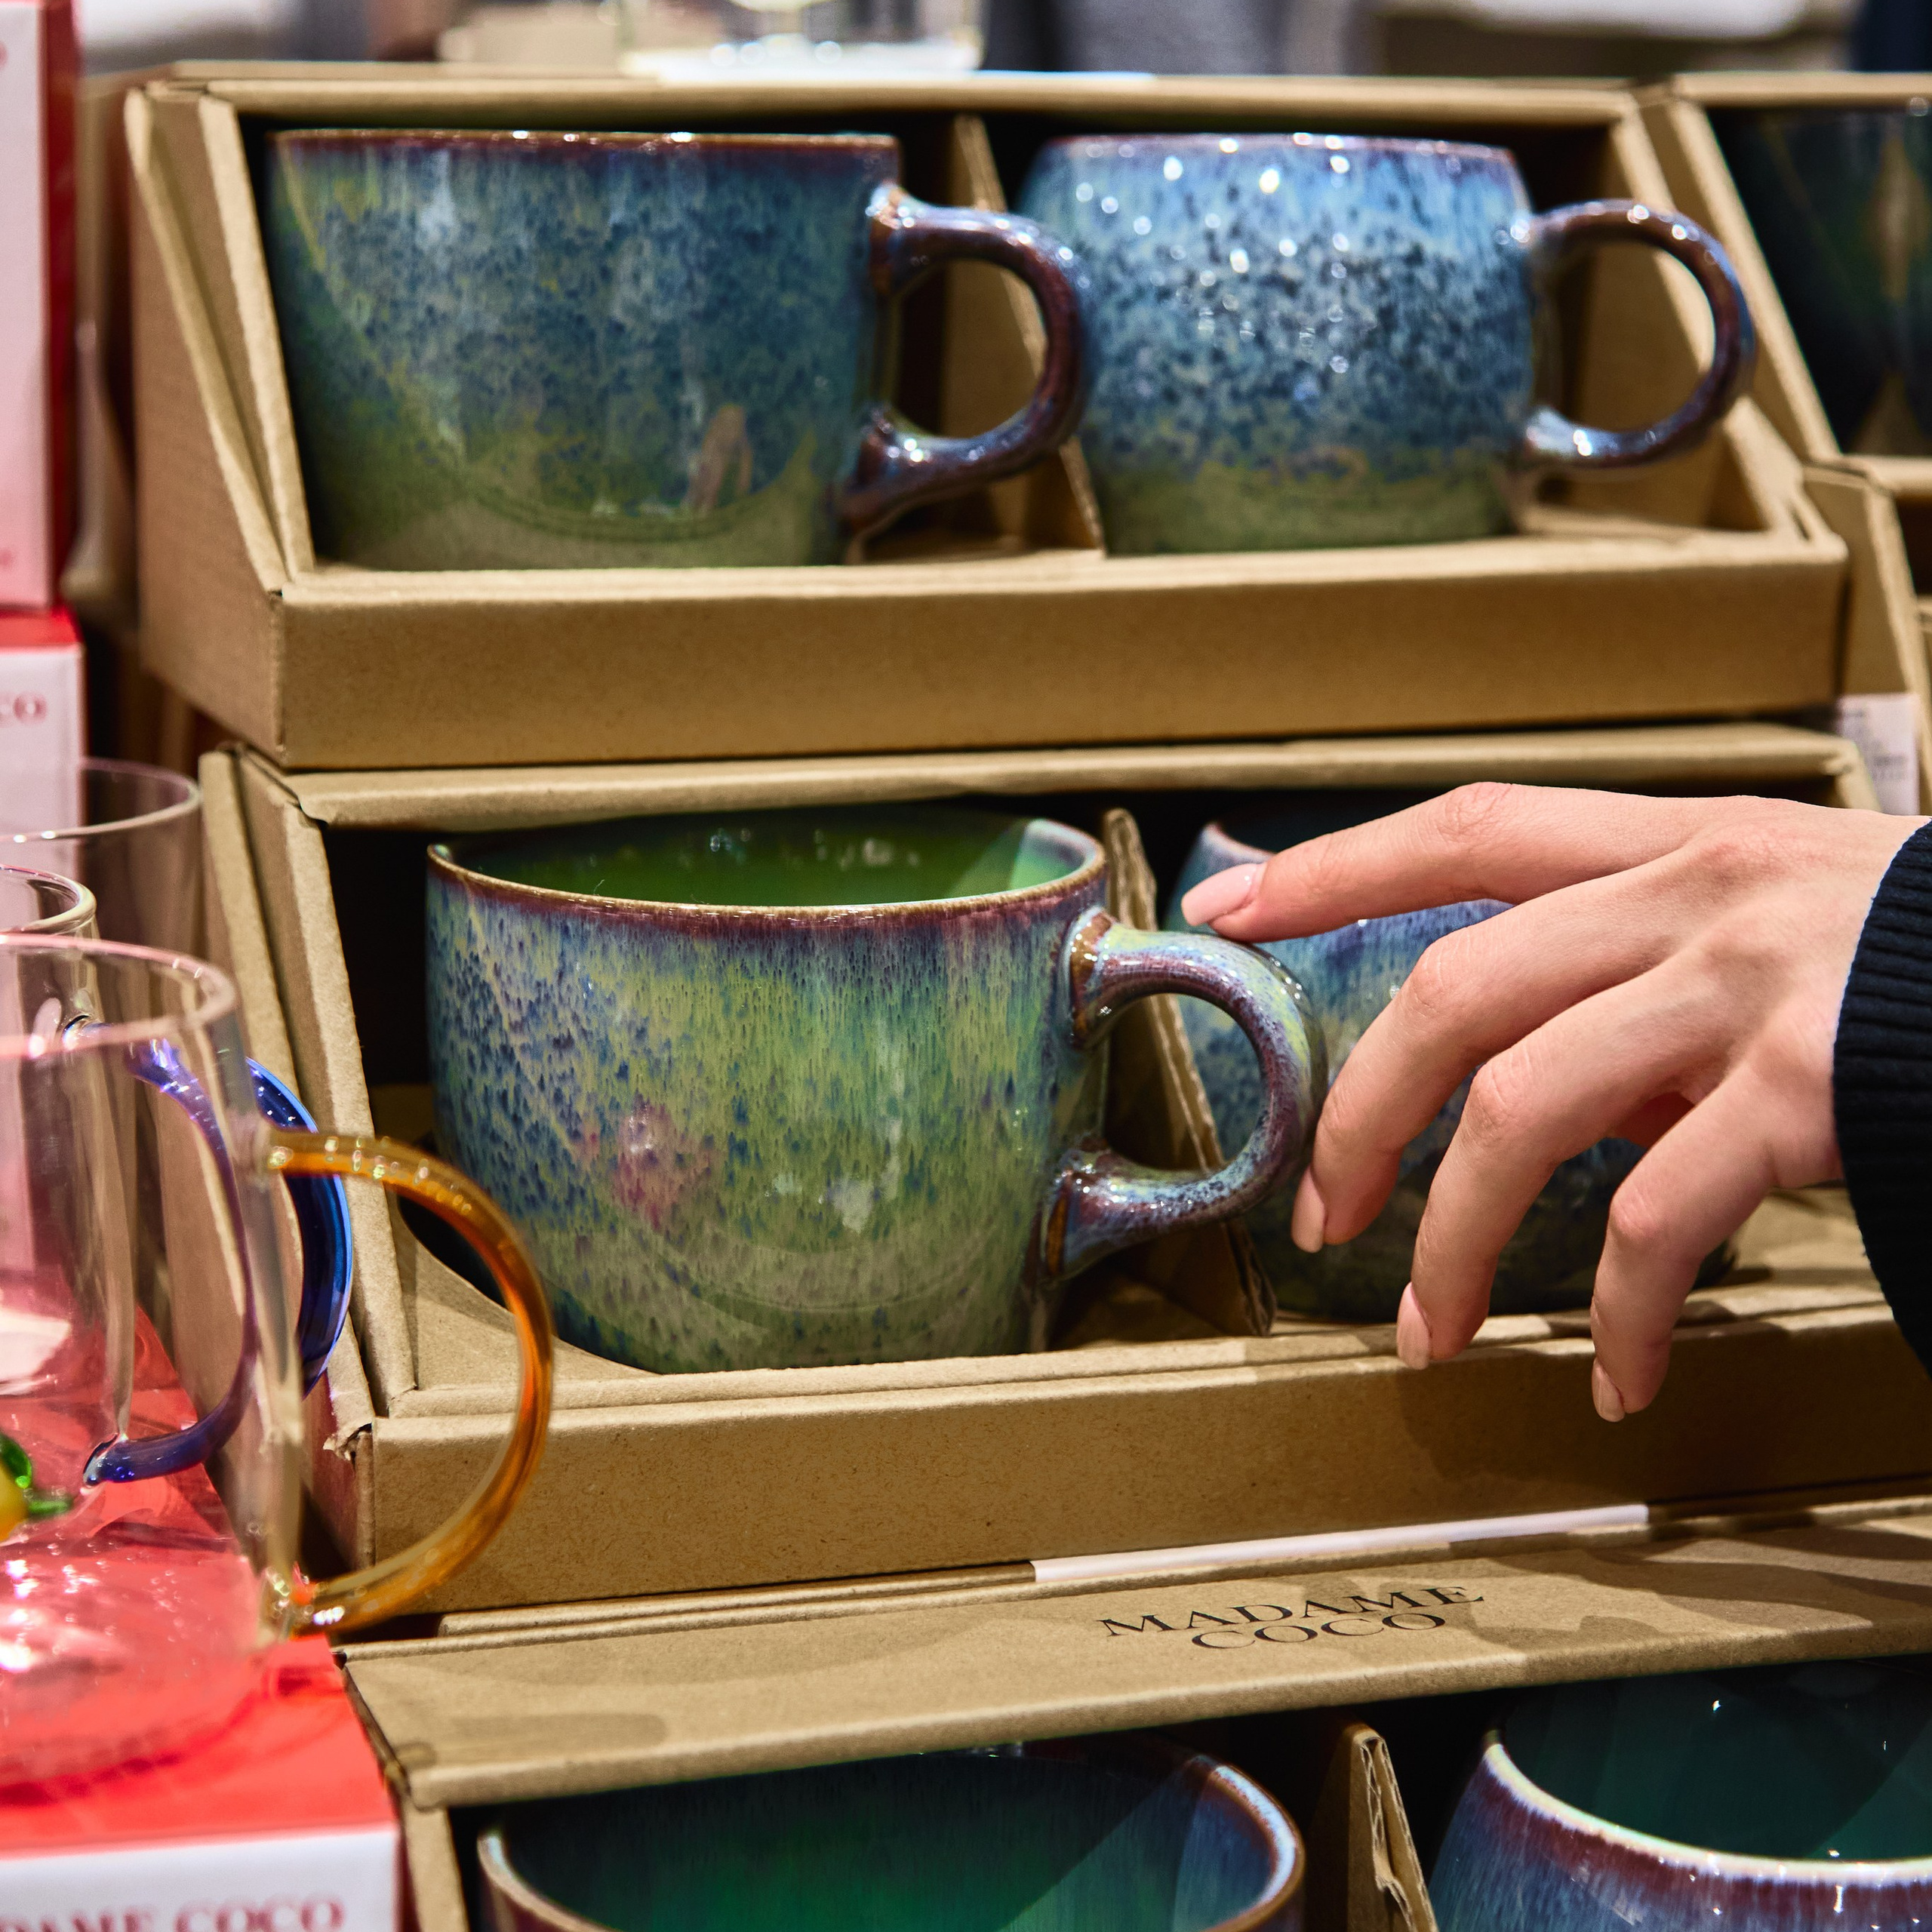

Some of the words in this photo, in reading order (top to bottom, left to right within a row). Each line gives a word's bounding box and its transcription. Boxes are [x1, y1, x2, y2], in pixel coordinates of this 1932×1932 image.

[1097, 1586, 1484, 1637] MADAME
[1192, 1613, 1446, 1650] COCO
[173, 1894, 346, 1932] COCO
